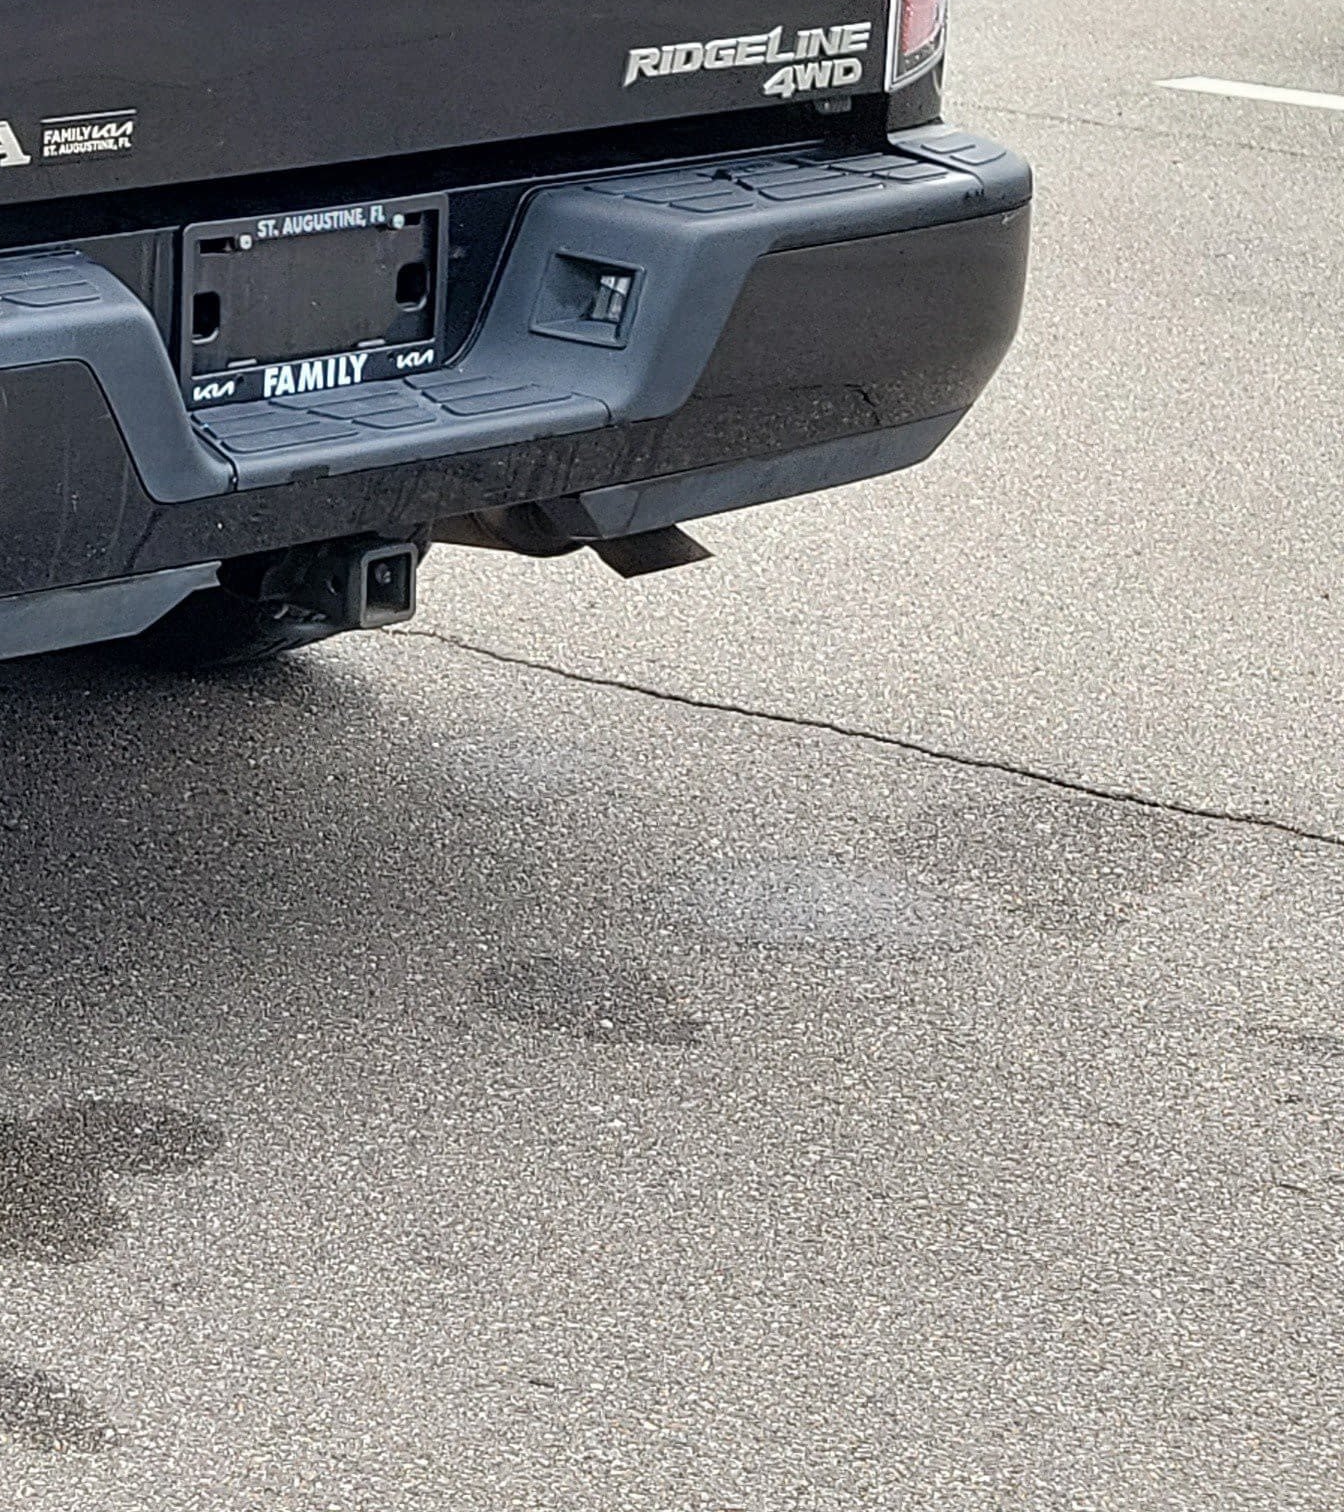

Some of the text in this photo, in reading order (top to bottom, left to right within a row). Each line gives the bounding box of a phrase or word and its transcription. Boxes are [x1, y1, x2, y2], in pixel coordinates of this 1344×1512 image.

[622, 22, 871, 88] RIDGELINE
[763, 58, 863, 99] 4WD
[43, 126, 92, 144] FAMILY
[43, 145, 58, 157] ST.
[118, 137, 132, 148] FL
[257, 205, 385, 238] ST. AUGUSTINE, FL
[193, 349, 434, 401] KIA FAMILY KIA
